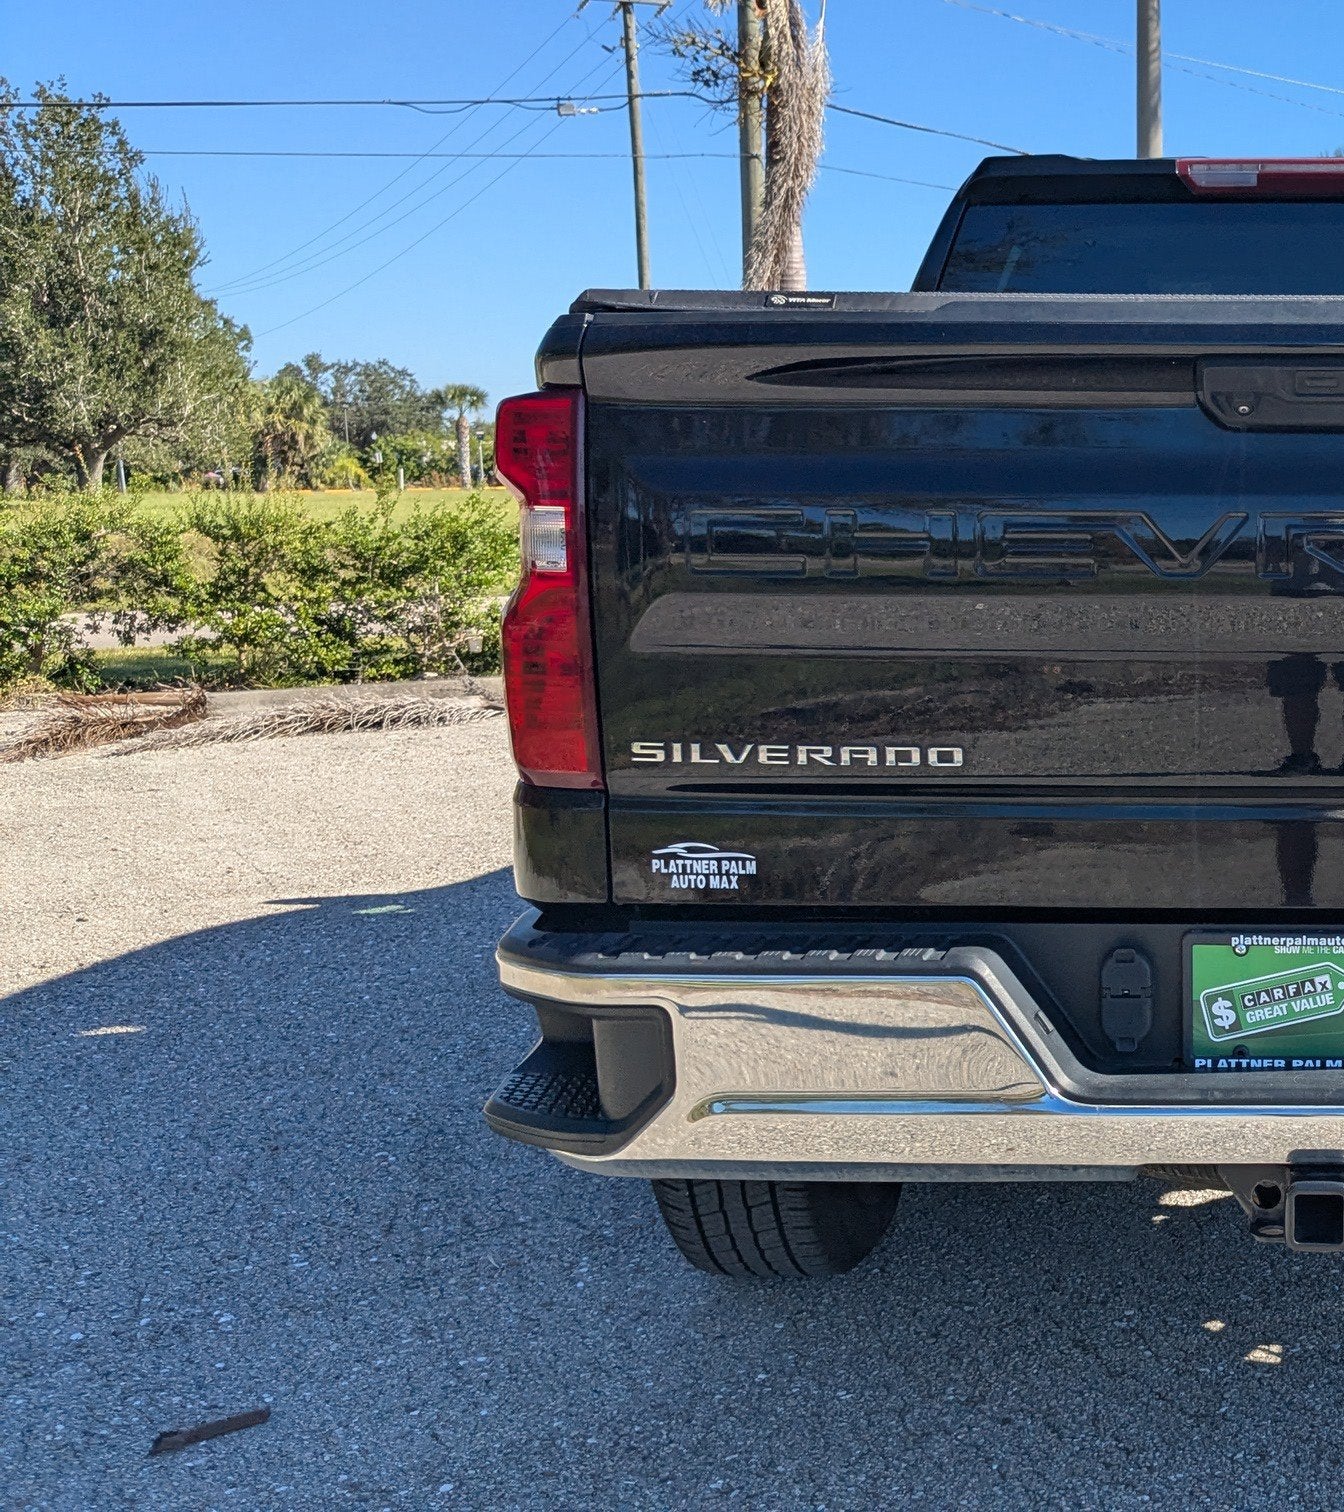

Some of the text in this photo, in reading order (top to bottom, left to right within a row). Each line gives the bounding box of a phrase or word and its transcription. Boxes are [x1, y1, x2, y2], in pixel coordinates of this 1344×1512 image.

[630, 741, 964, 767] SILVERADO
[651, 859, 757, 875] PLATTNER PALM
[670, 874, 739, 890] AUTO MAX
[1274, 946, 1301, 954] SHOW
[1302, 946, 1315, 954] ME
[1316, 946, 1331, 954] THE
[1242, 976, 1331, 1008] CARFAX
[1245, 993, 1335, 1023] GREAT VALUE
